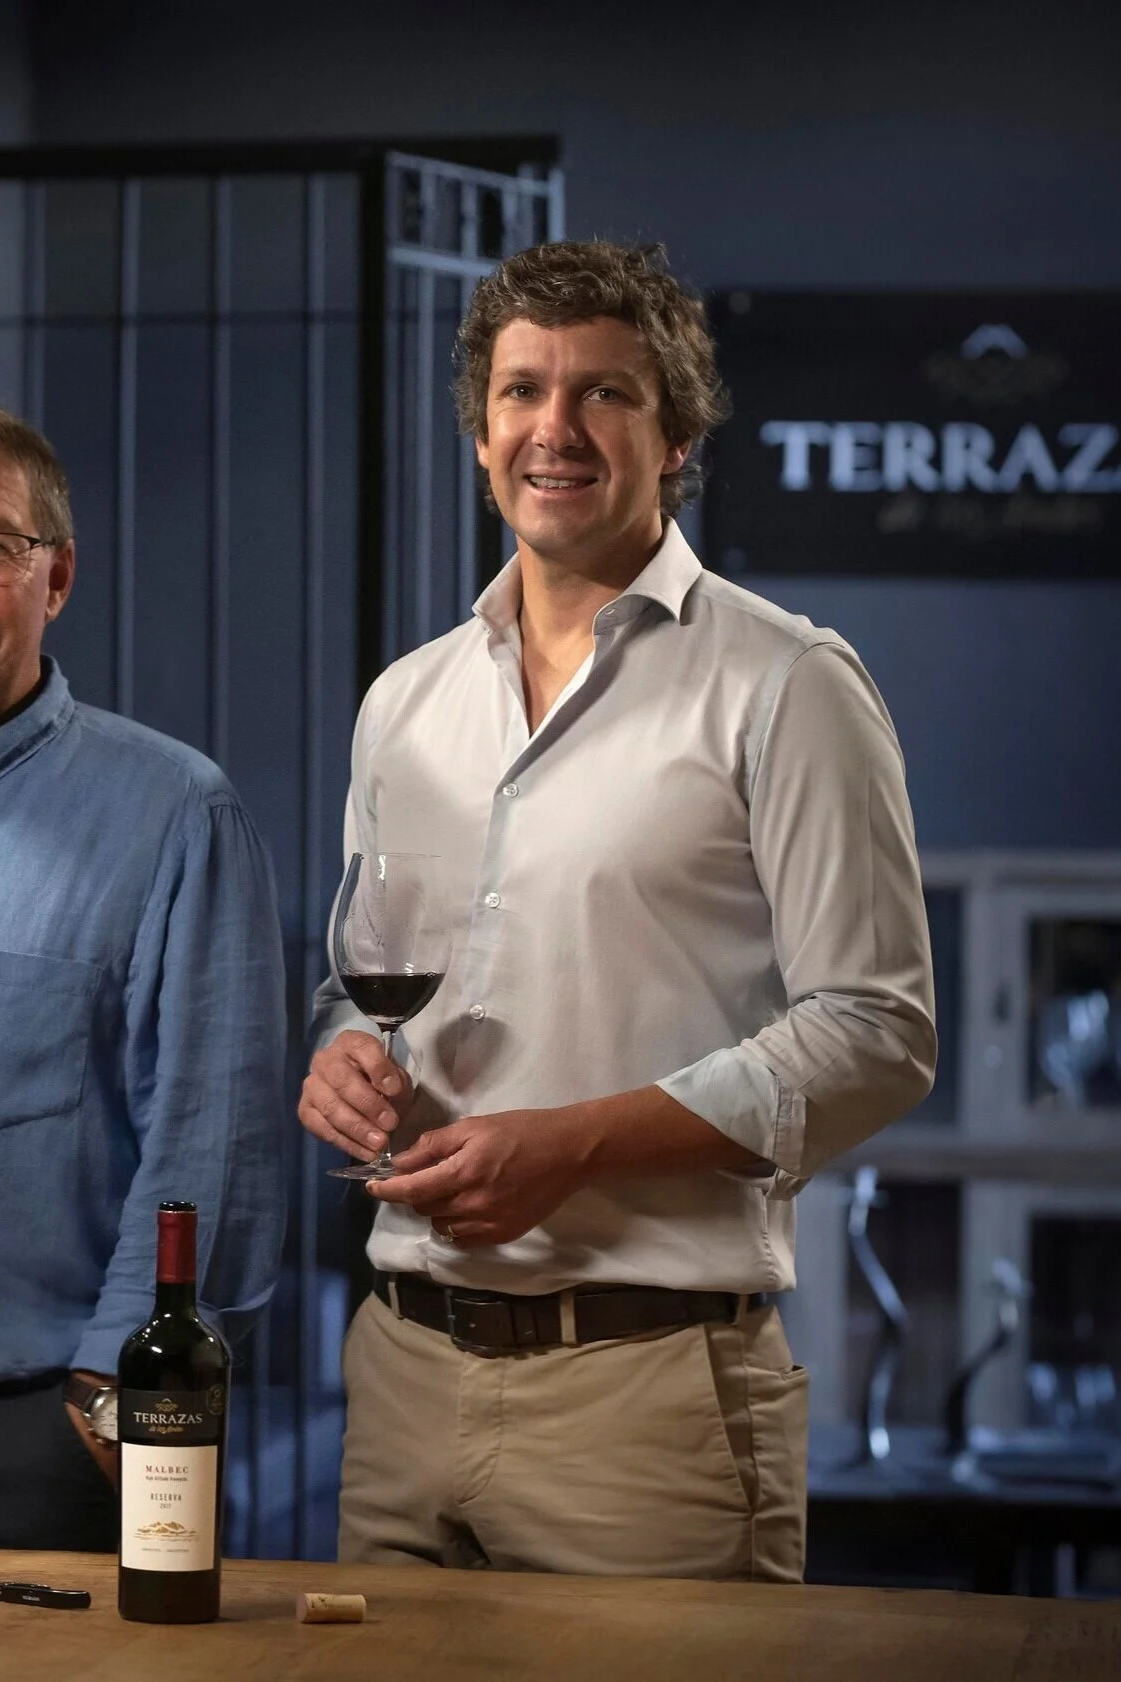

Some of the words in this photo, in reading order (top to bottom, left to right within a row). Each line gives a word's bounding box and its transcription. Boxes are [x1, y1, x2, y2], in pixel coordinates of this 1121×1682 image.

[760, 420, 1121, 493] TERRAZ
[133, 1411, 203, 1424] TERRAZAS
[145, 1465, 189, 1474] MALBEC
[150, 1493, 182, 1502] RESERVA
